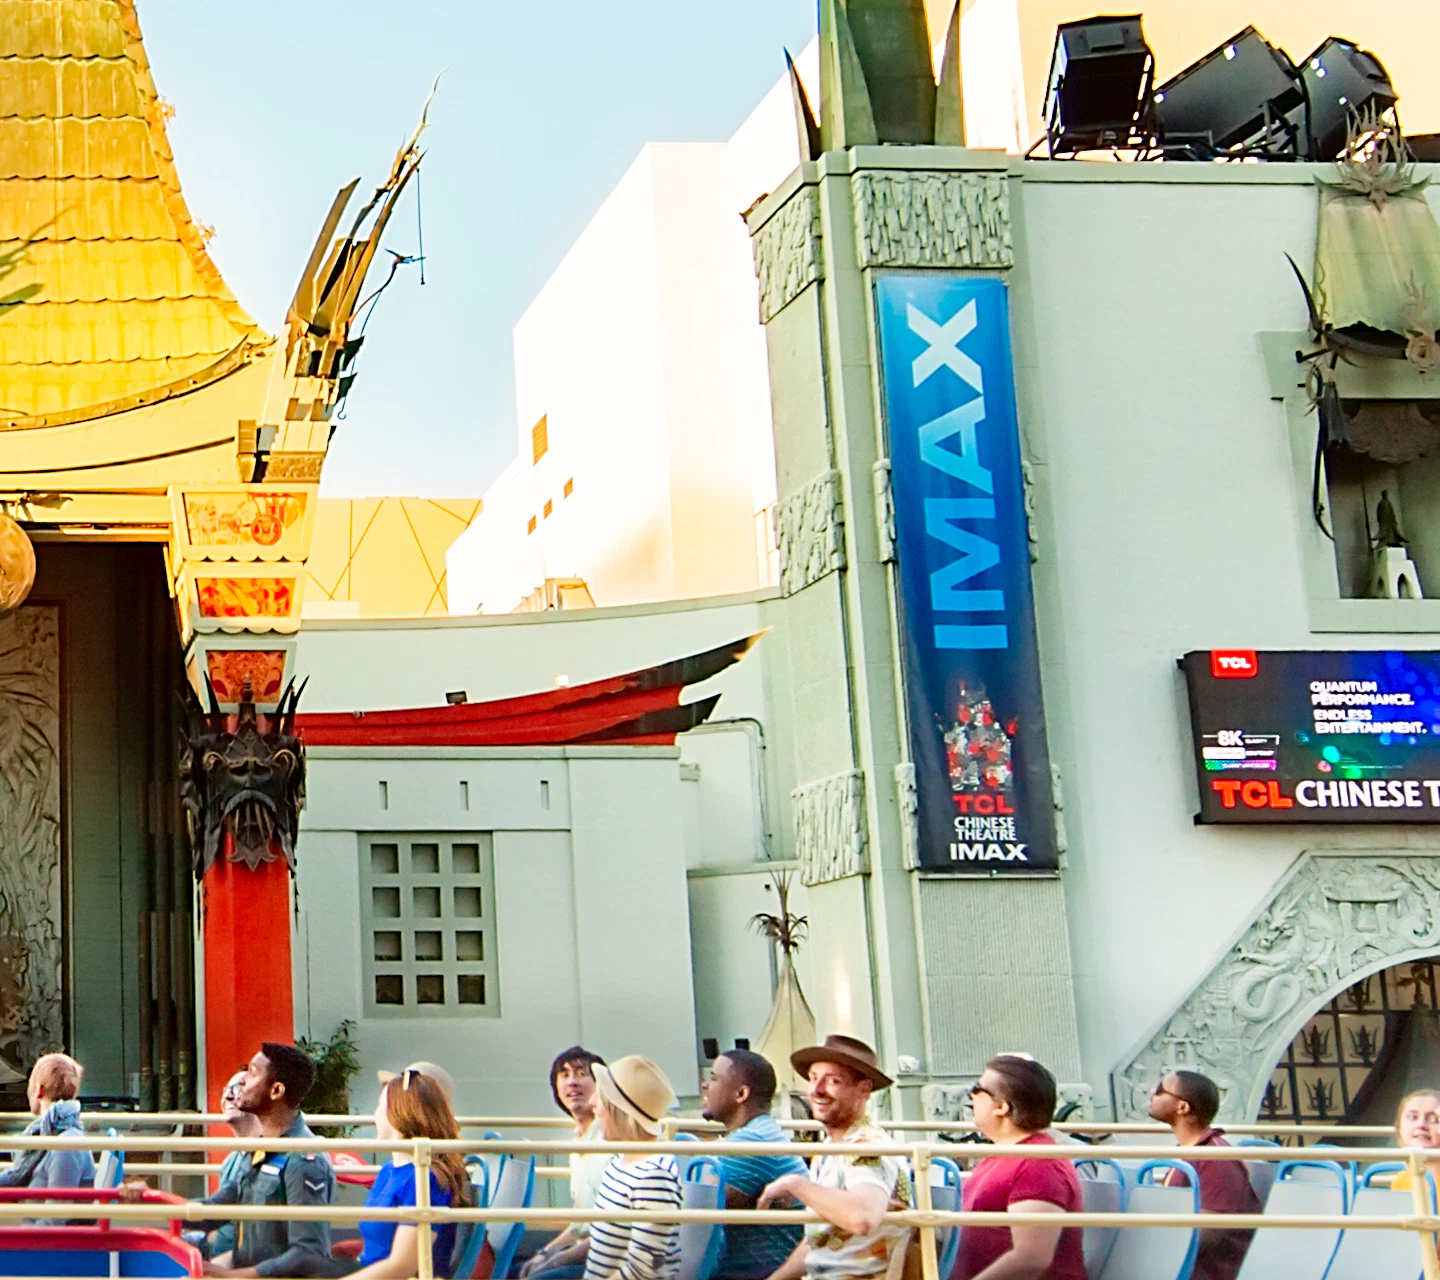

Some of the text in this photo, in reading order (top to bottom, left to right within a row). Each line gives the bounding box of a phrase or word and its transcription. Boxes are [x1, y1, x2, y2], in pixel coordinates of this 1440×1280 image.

[906, 297, 1009, 651] IMAX
[1219, 657, 1252, 669] TCL
[1309, 681, 1378, 694] QUANTUM
[1311, 694, 1415, 707] PERFORMANCE.
[1313, 709, 1373, 721] ENDLESS
[1315, 721, 1428, 734] ENTERTAINMENT.
[1218, 730, 1244, 746] 8K
[1212, 779, 1294, 808] TCL
[1295, 780, 1423, 808] CHINESE
[952, 794, 1015, 815] TCL
[953, 816, 1016, 829] CHINESE
[954, 828, 1018, 841] THEATRE
[949, 843, 1029, 861] IMAX
